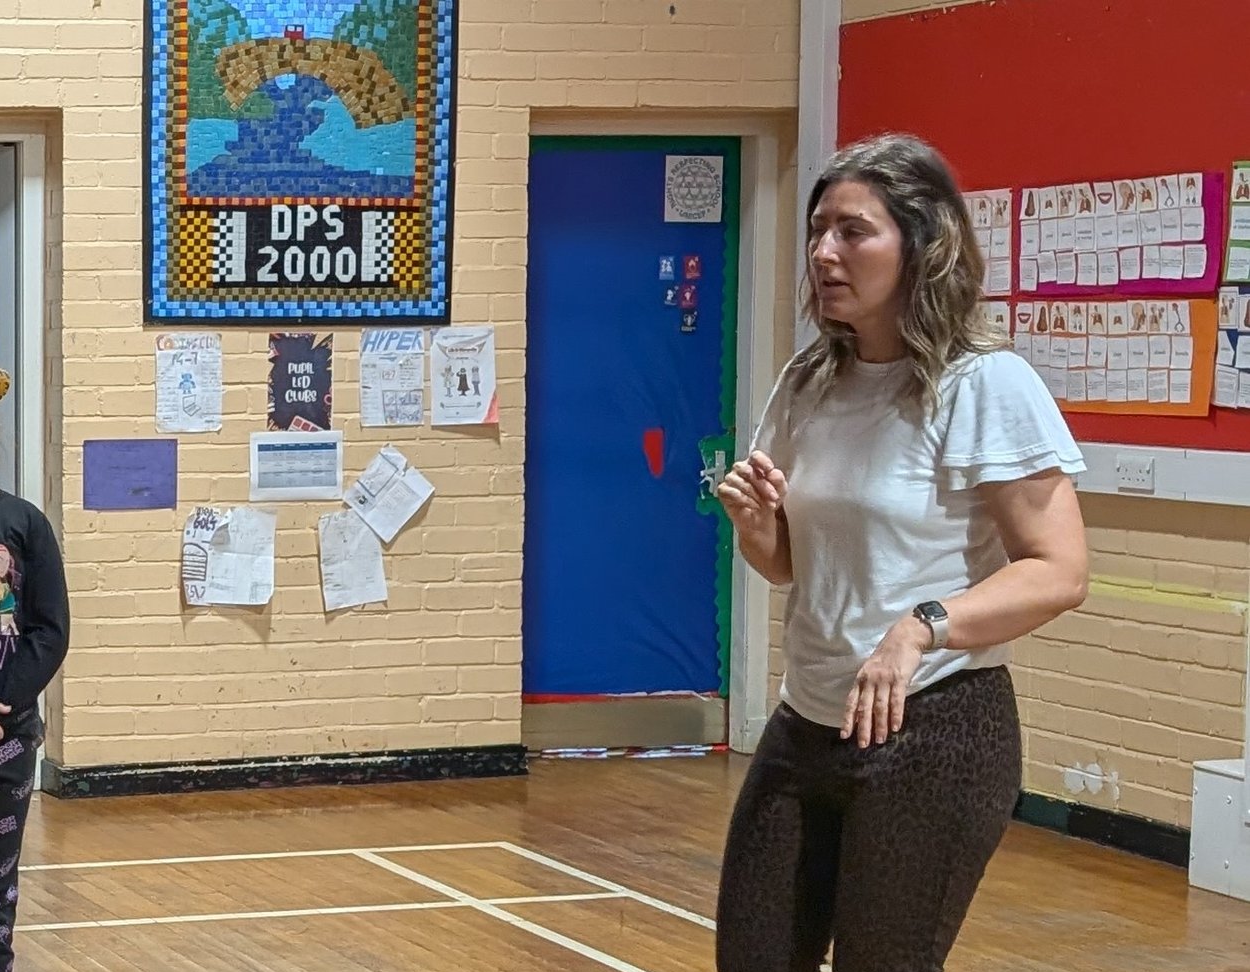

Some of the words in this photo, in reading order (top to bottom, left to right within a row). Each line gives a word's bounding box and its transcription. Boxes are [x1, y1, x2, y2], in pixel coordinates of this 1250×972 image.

[271, 204, 344, 241] DPS
[257, 245, 357, 283] 2000
[284, 389, 317, 404] CLUBS
